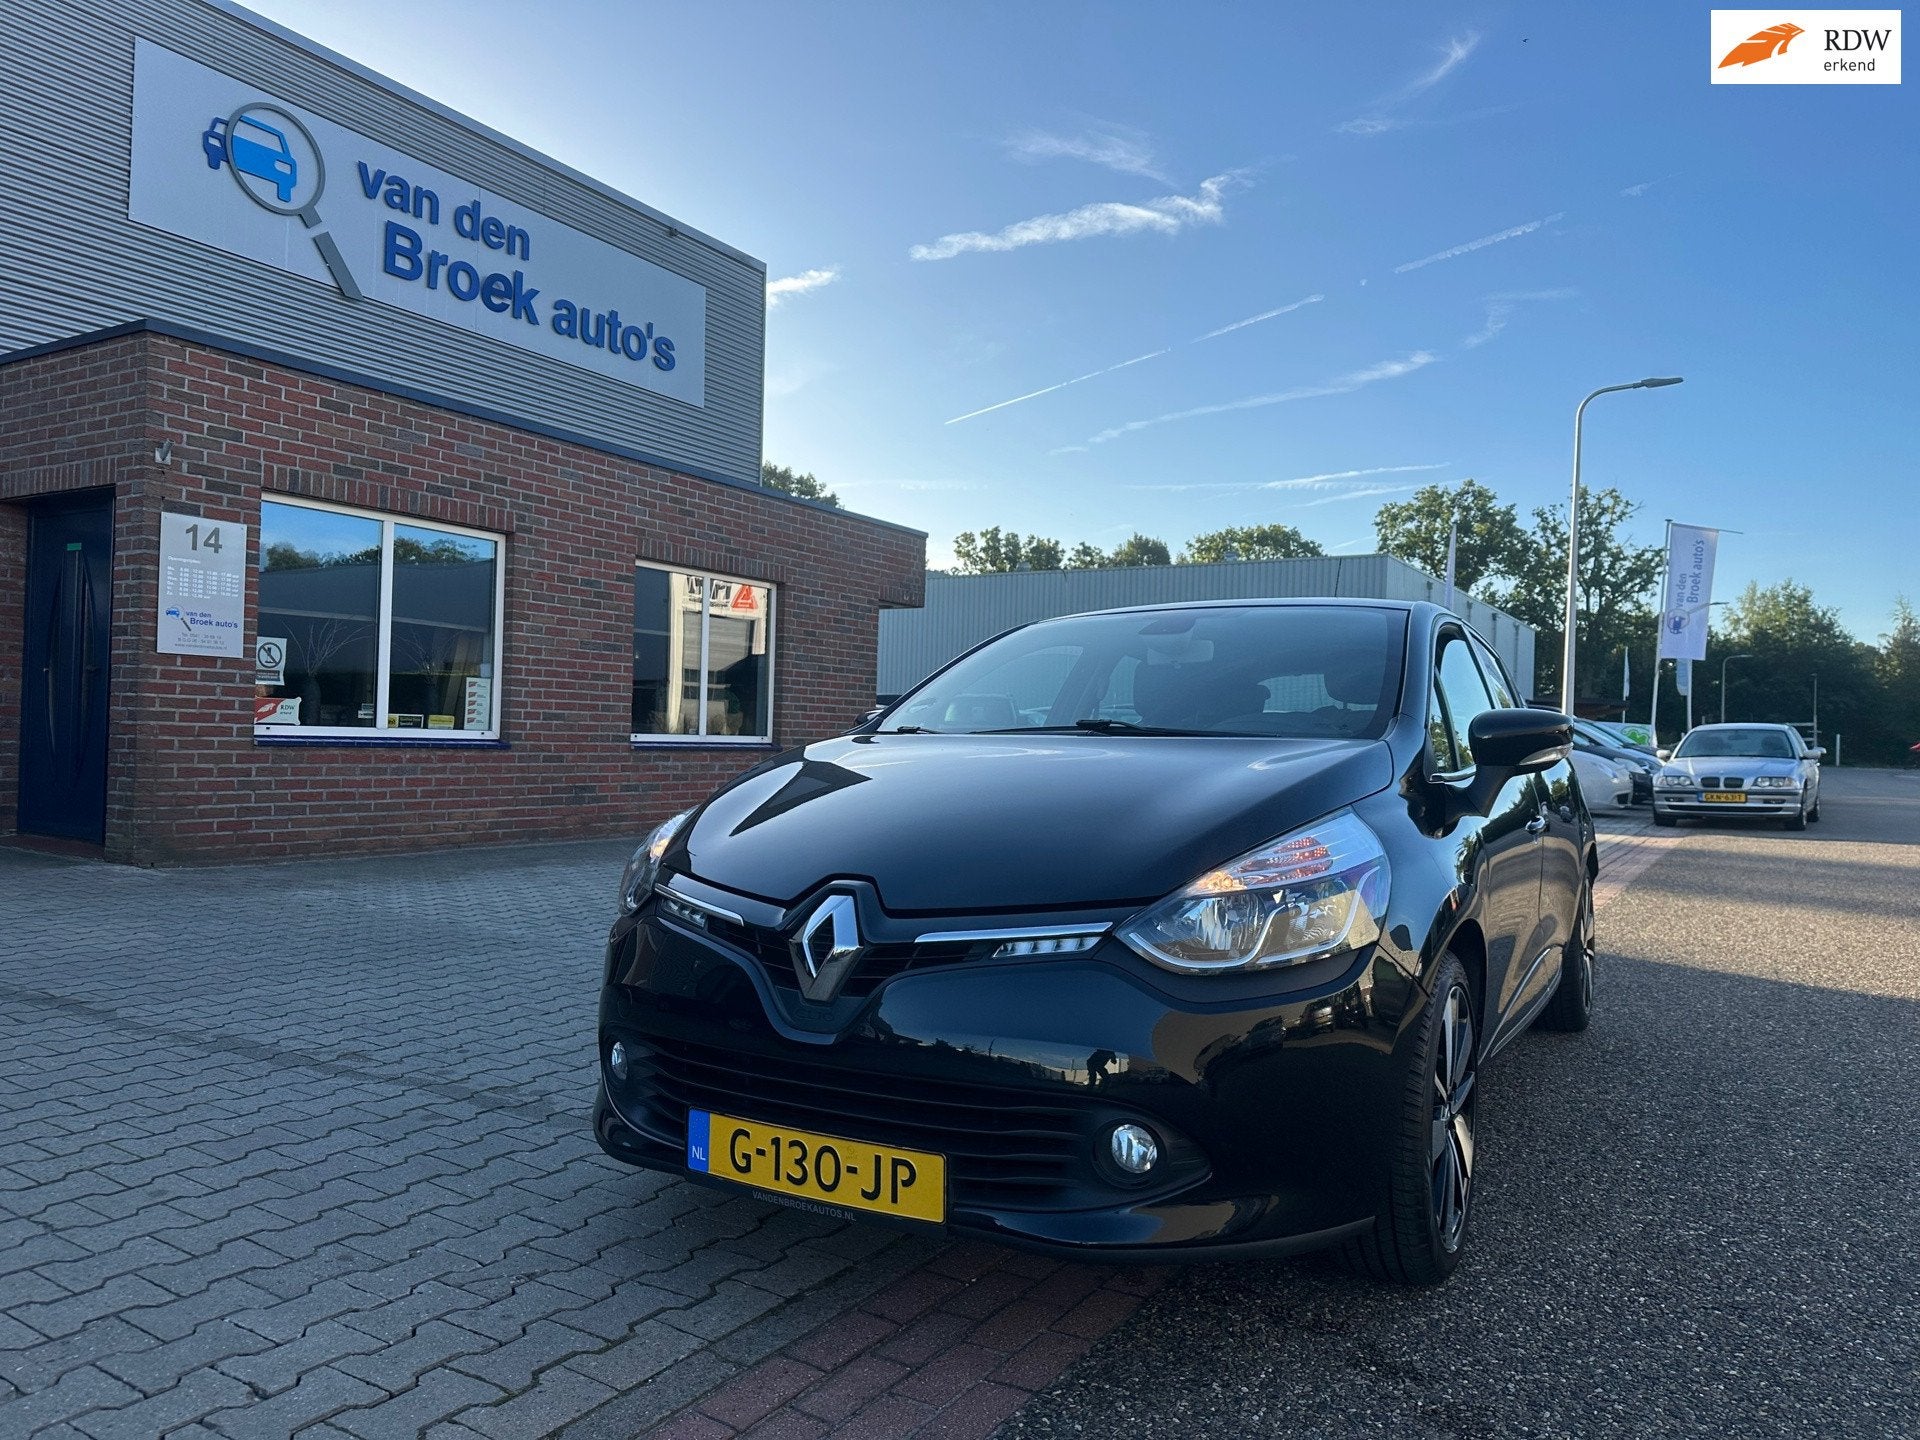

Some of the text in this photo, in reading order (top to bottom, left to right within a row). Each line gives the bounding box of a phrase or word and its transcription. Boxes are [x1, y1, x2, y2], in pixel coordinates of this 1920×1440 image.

[357, 160, 530, 261] van den
[384, 220, 677, 372] Broek auto's
[185, 523, 223, 554] 14
[1686, 539, 1705, 604] Broek auto's
[1675, 573, 1687, 608] van den
[190, 617, 239, 629] Broek auto's
[691, 1145, 706, 1161] NL
[729, 1128, 917, 1204] G-130-JP
[752, 1190, 857, 1221] VANDENBROEKAUTOS.NL
